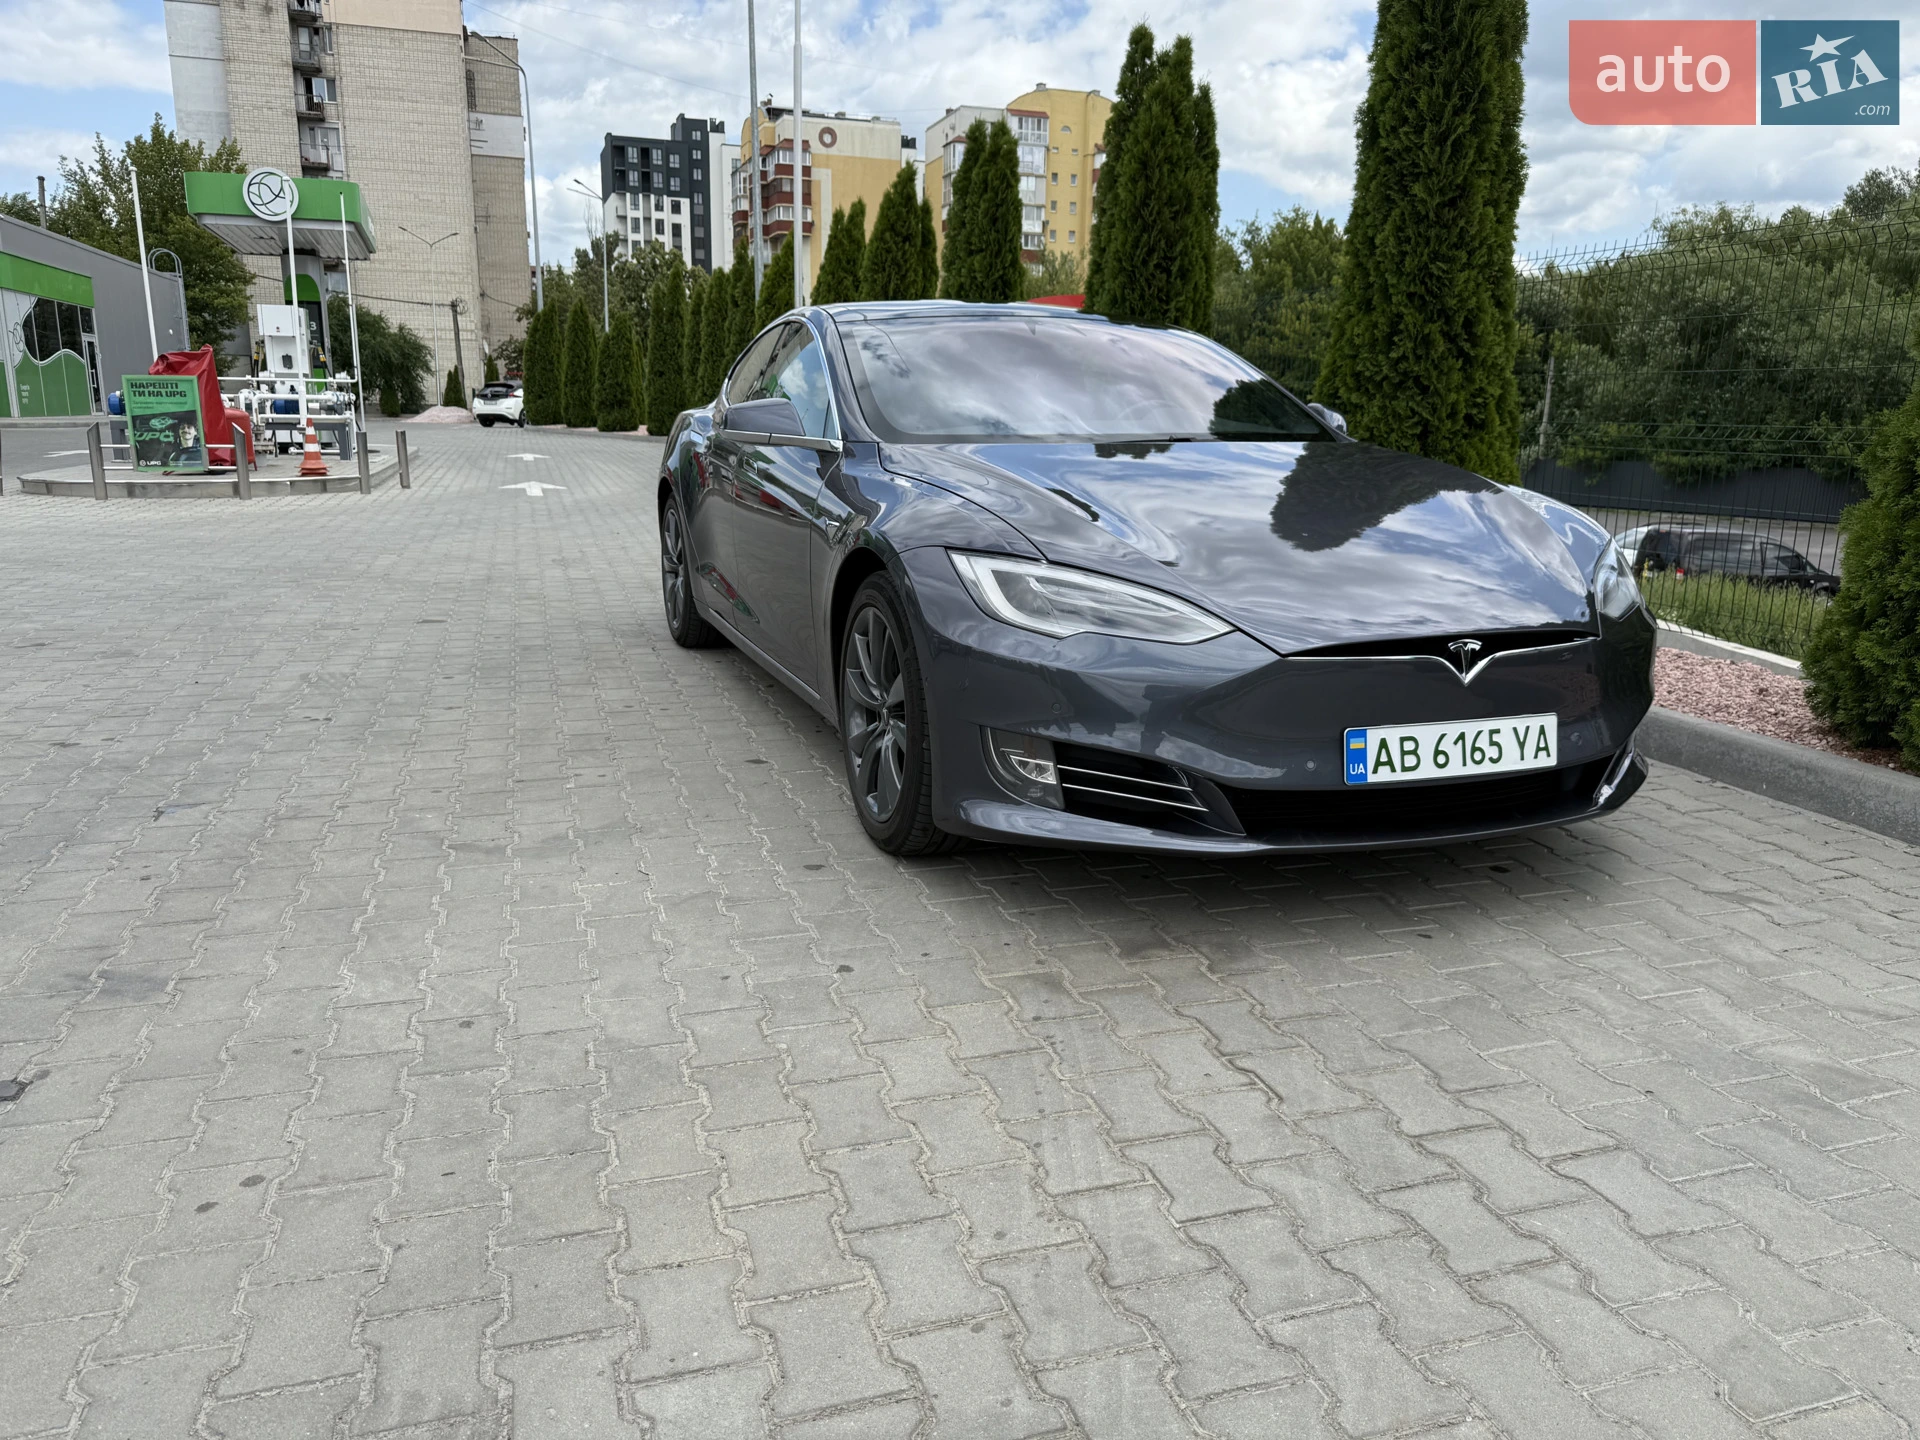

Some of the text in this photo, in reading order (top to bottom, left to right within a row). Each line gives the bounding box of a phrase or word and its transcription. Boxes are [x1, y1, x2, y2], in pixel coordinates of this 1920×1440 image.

[1371, 724, 1551, 774] AB 6165 YA
[1349, 762, 1366, 775] UA
